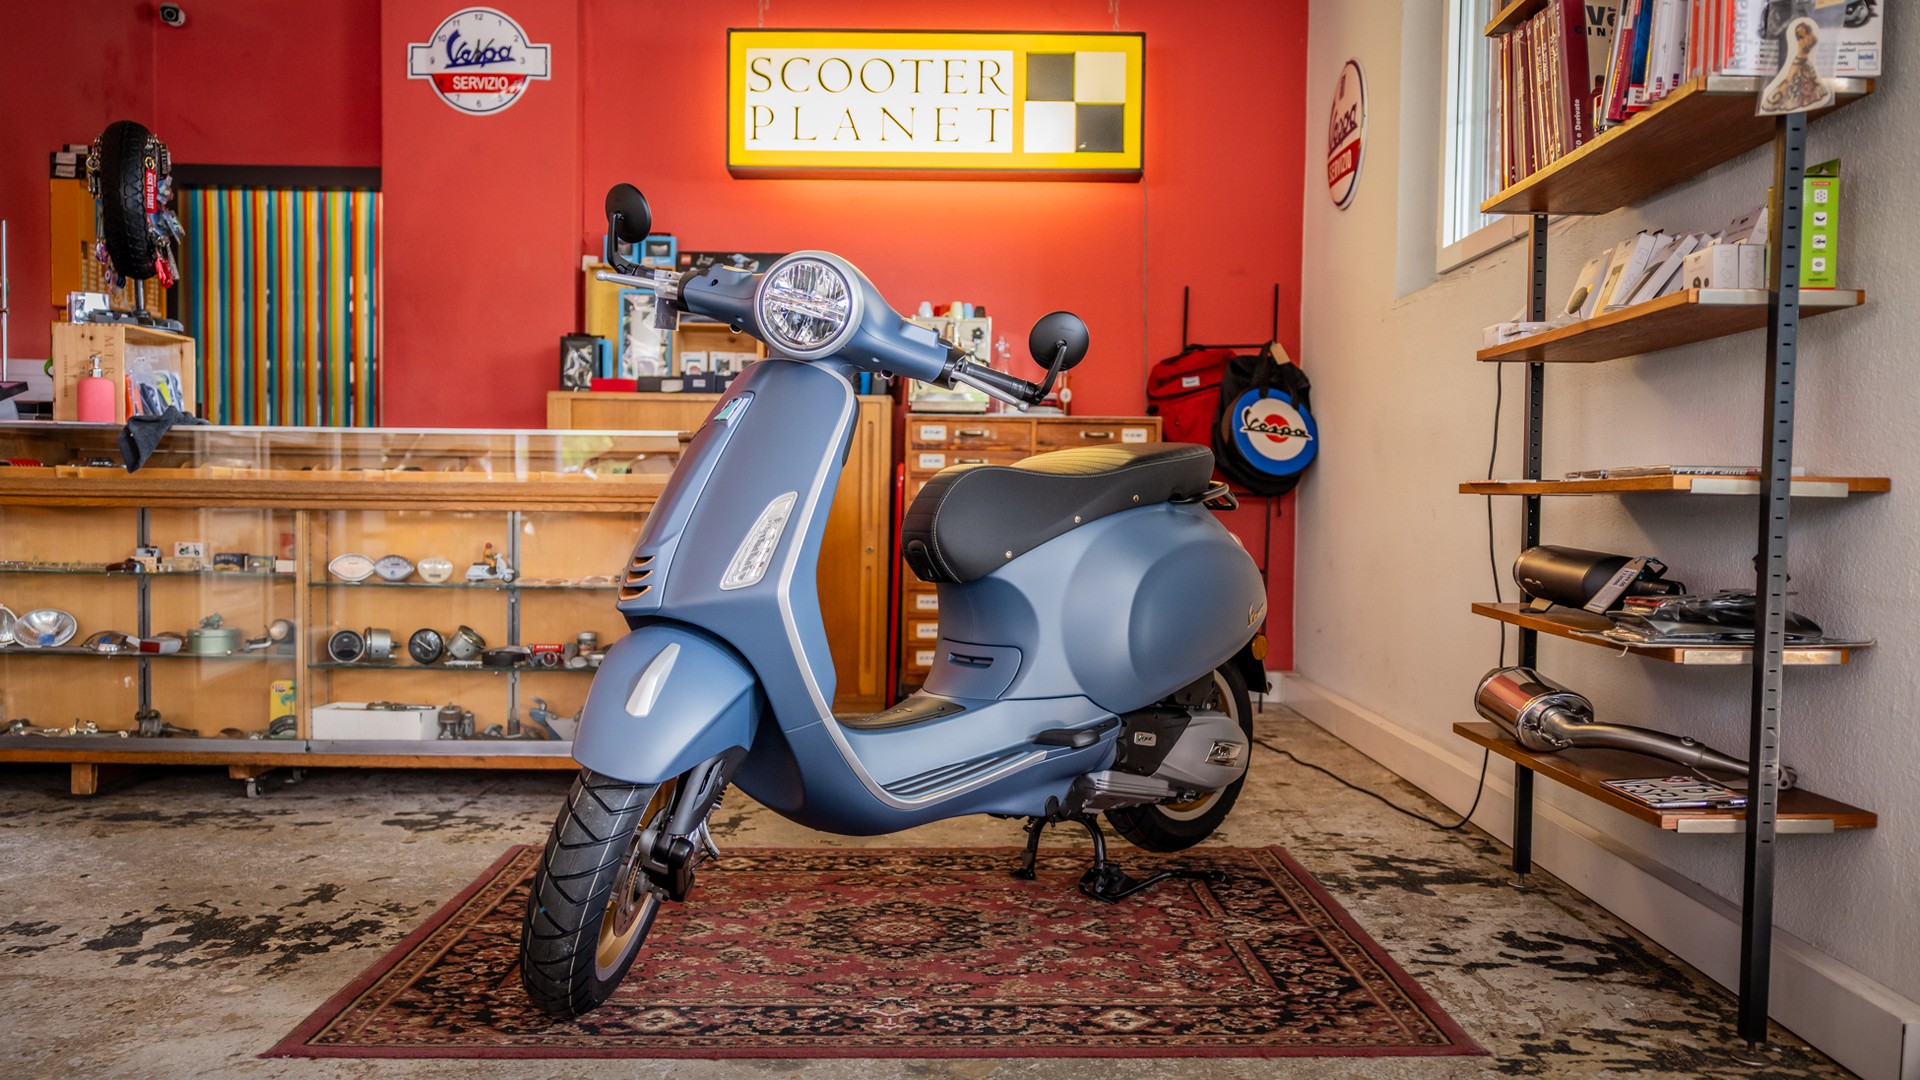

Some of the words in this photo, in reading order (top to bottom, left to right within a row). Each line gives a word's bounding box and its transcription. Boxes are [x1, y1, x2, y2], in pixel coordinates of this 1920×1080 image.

[444, 29, 515, 69] Vespa
[452, 76, 509, 91] SERVIZIO
[749, 57, 1009, 96] SCOOTER
[750, 105, 1009, 143] PLANET
[1574, 98, 1582, 131] Derivate
[1328, 149, 1352, 182] SERVIZIO
[147, 193, 155, 209] START
[1242, 407, 1311, 439] Vespa
